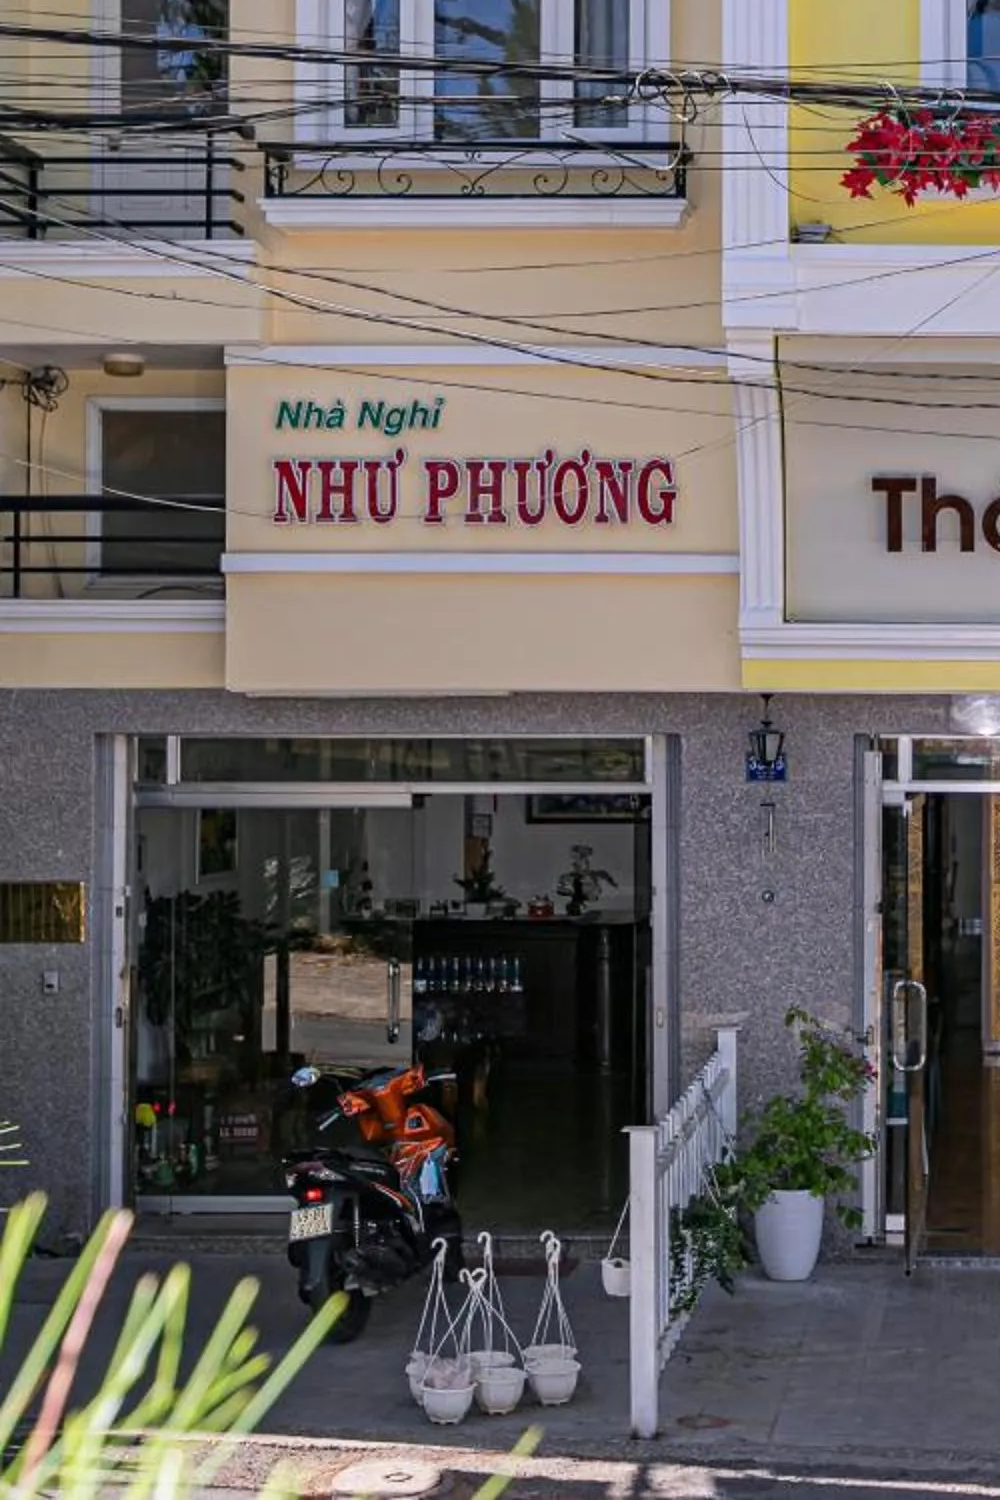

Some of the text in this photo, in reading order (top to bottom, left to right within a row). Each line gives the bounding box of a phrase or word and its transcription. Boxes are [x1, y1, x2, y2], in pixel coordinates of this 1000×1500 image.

[274, 396, 446, 436] Nhà Nghỉ
[272, 447, 678, 526] NHƯ PHƯƠNG
